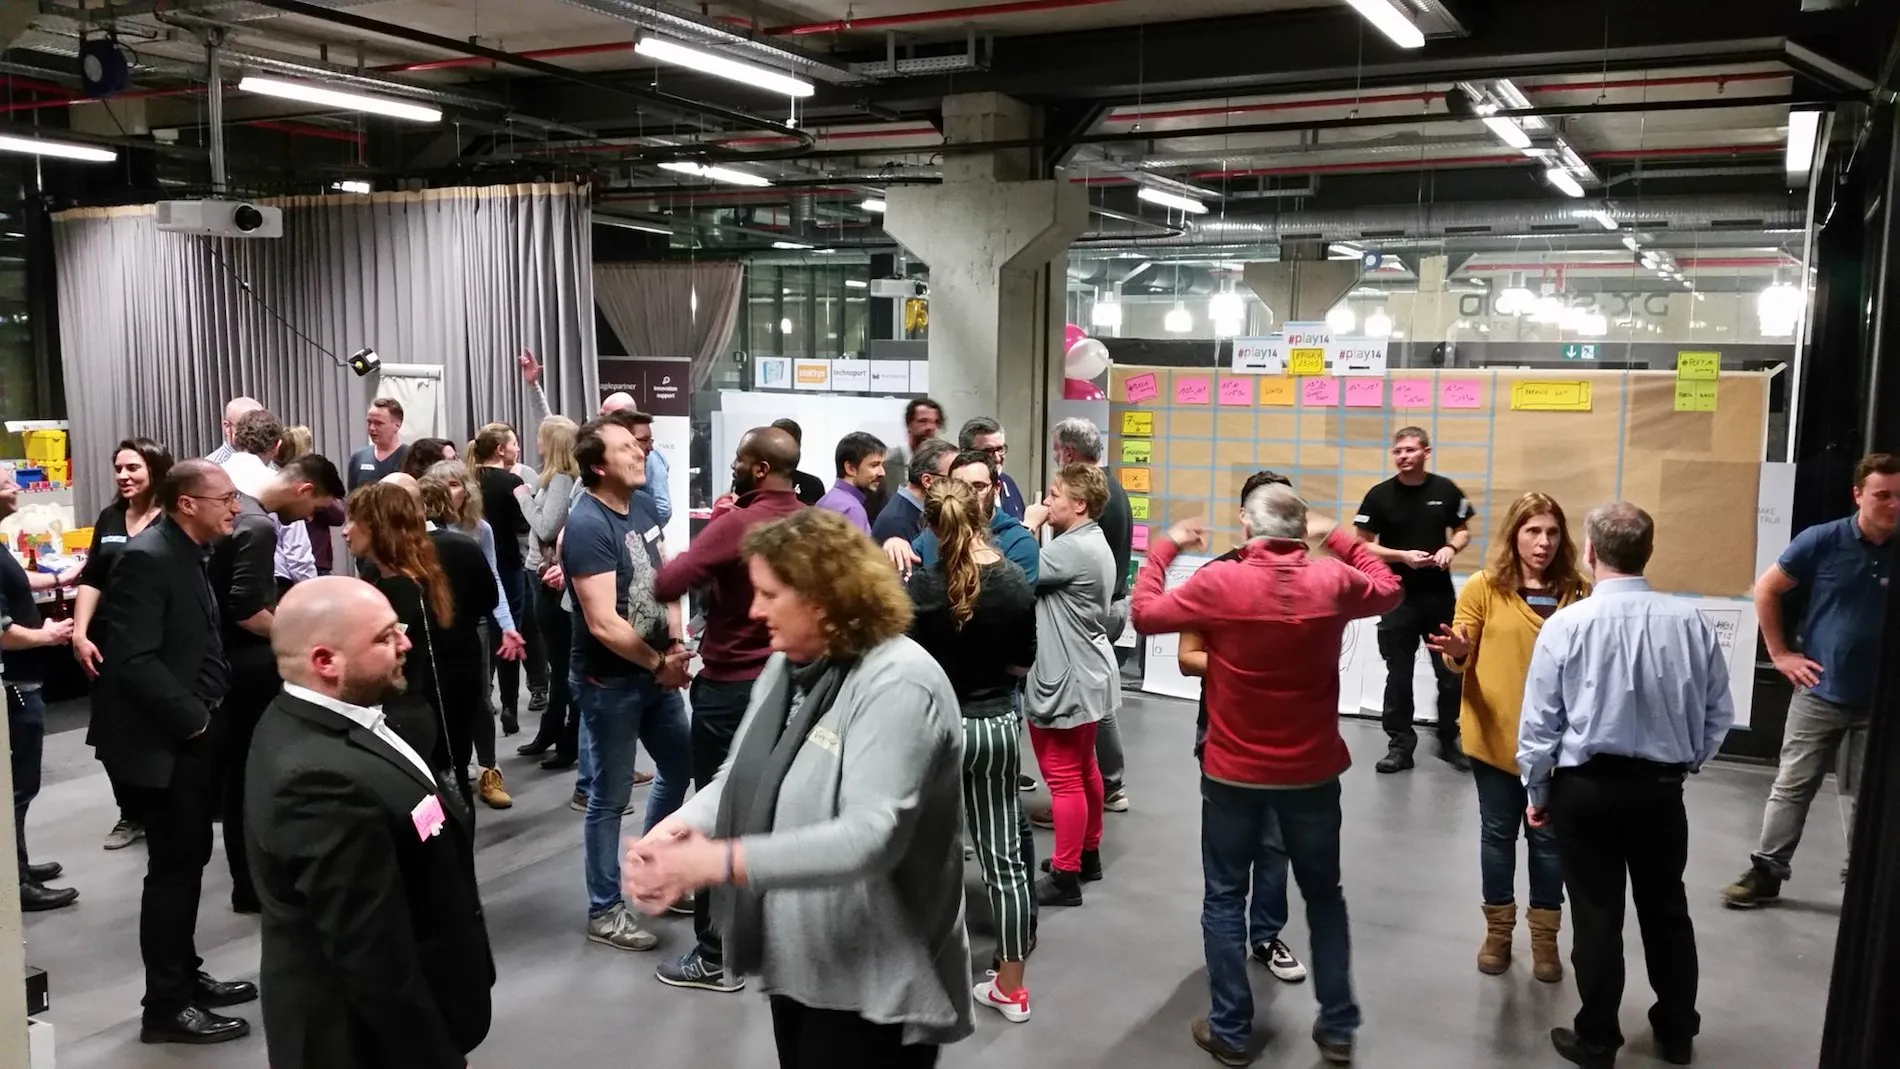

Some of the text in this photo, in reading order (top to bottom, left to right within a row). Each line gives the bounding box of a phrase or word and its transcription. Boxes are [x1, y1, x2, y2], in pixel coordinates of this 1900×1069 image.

[1288, 333, 1330, 346] #play14
[1238, 347, 1278, 360] #play14
[1339, 348, 1382, 361] #play14
